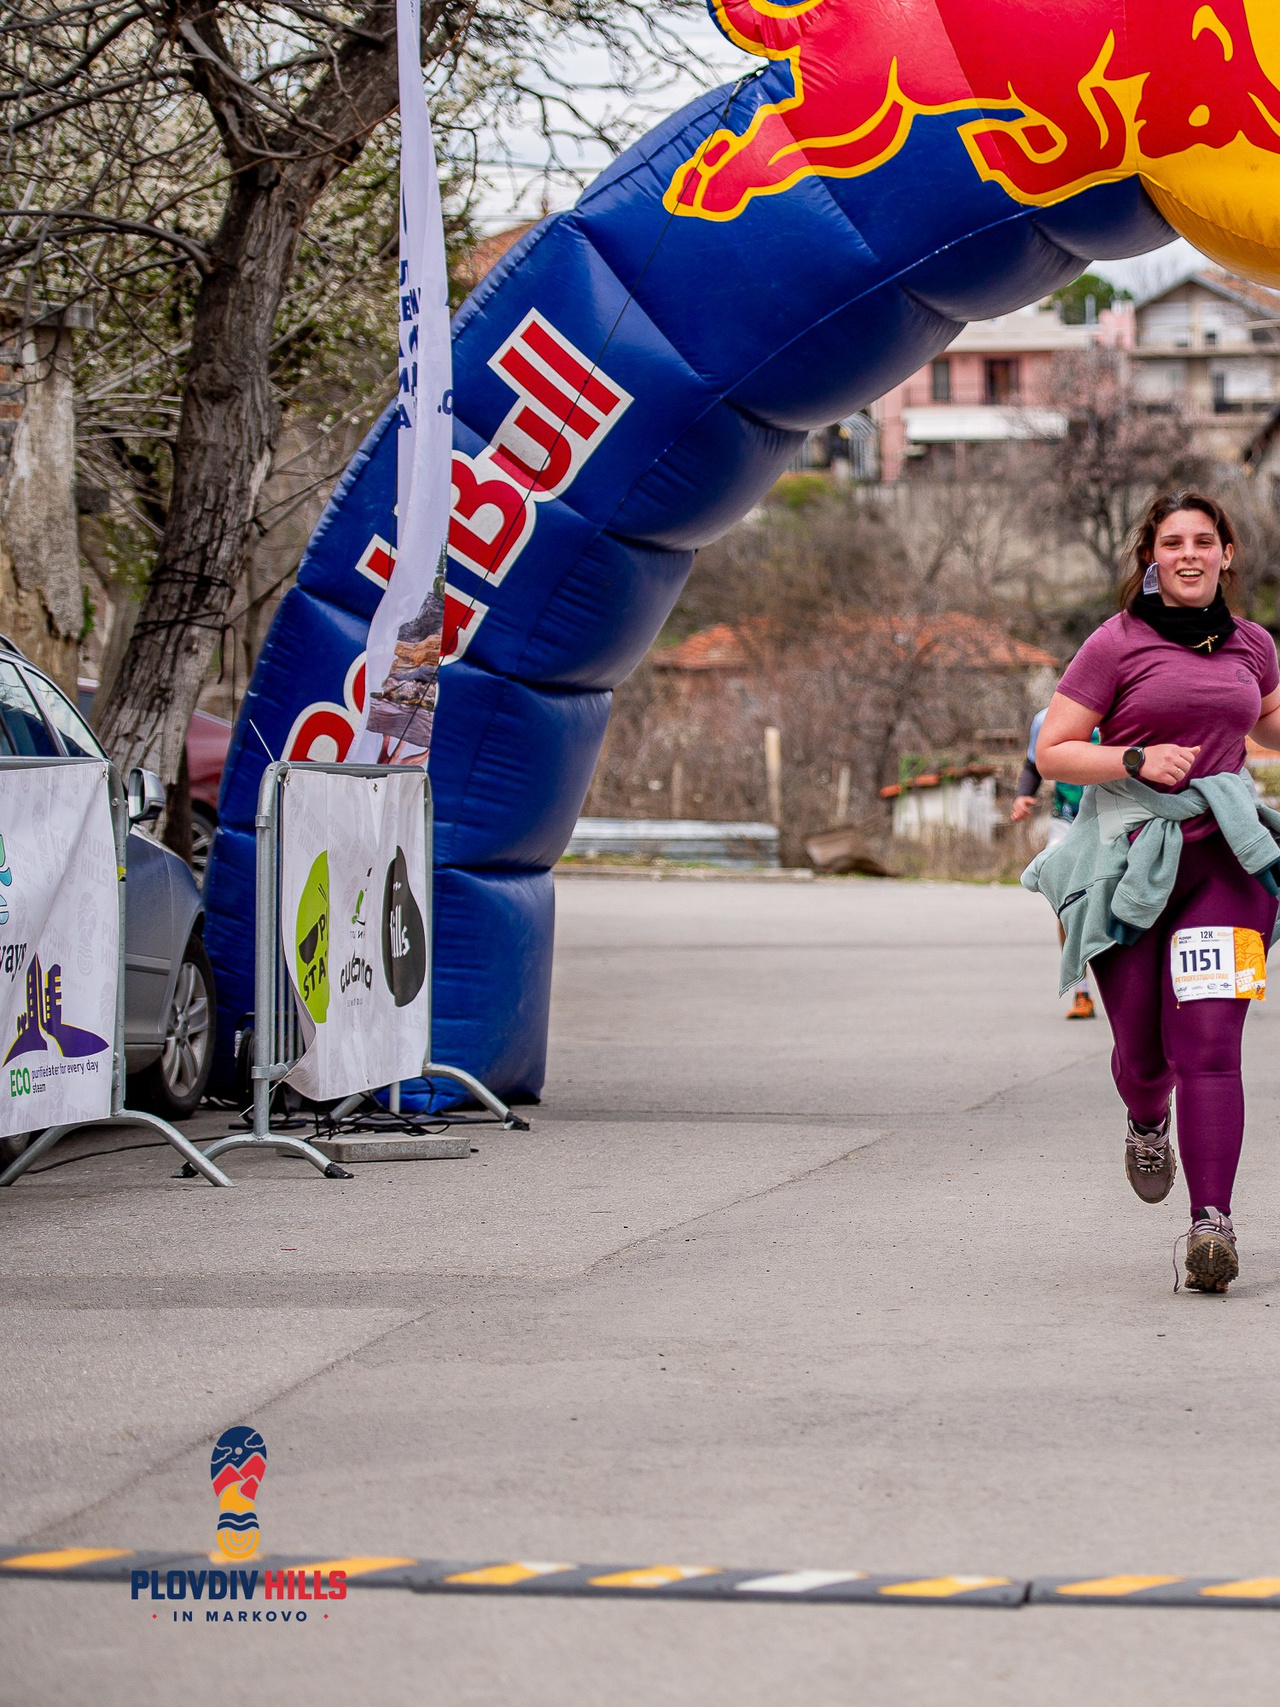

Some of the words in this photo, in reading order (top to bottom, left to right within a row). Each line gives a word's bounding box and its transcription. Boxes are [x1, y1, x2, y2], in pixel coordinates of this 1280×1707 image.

[448, 315, 627, 581] Bull
[1200, 931, 1214, 939] 12K
[1179, 948, 1221, 973] 1151
[10, 1067, 31, 1097] ECO
[67, 1062, 85, 1076] every
[86, 1059, 99, 1073] day
